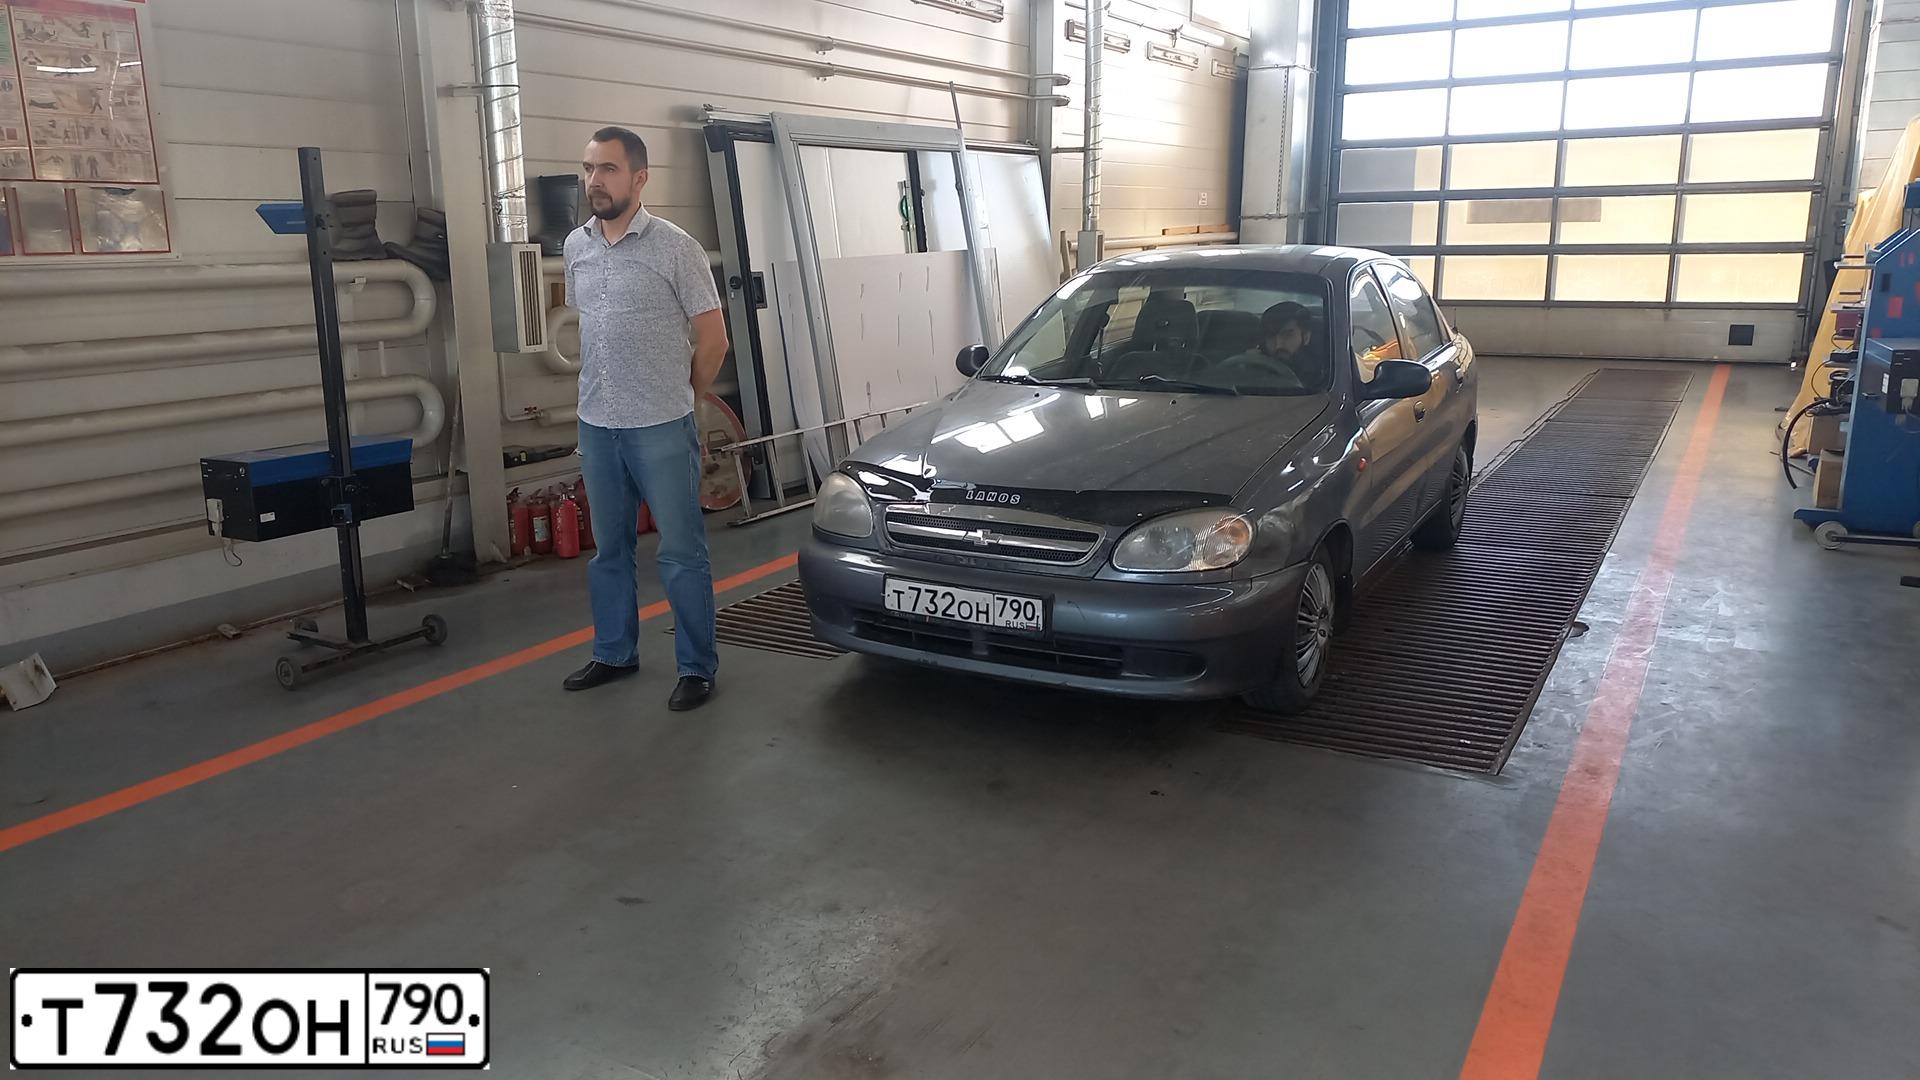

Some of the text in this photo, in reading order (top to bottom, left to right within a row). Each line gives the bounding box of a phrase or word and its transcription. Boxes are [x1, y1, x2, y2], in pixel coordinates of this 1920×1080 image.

[966, 490, 1020, 504] LANOS
[996, 597, 1036, 621] 790
[1005, 620, 1025, 630] RUS
